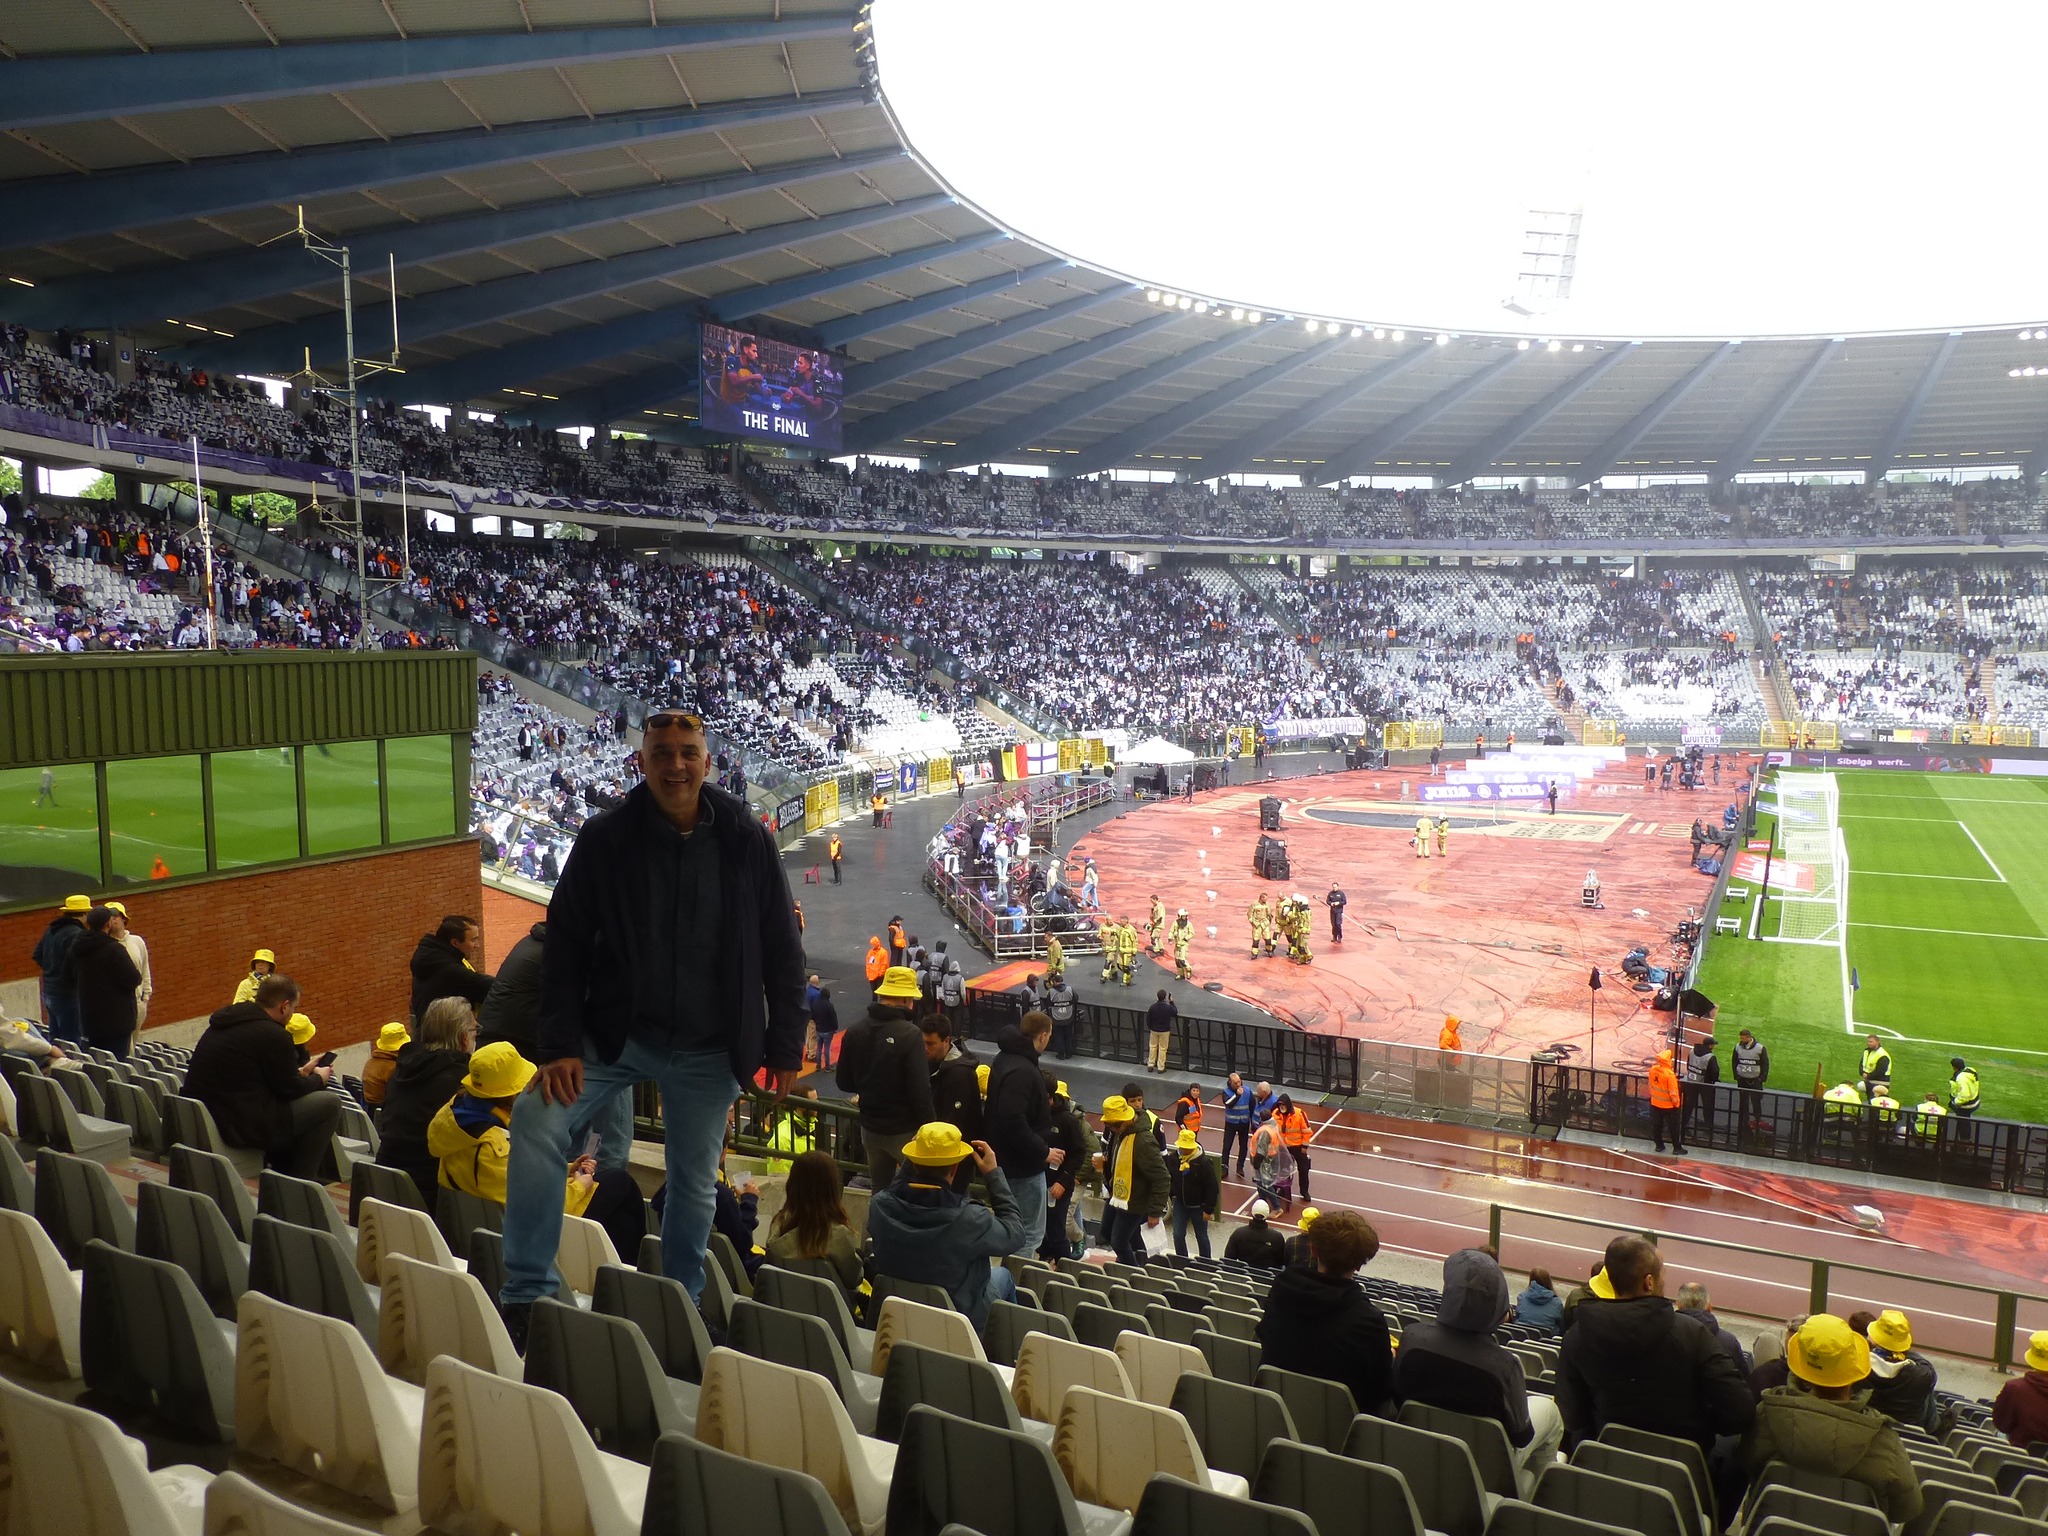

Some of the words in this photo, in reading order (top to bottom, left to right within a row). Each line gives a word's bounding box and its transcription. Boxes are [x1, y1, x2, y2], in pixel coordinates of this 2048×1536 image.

[742, 410, 769, 431] THE
[774, 416, 810, 438] FINAL
[1276, 719, 1310, 737] SOUTH
[1324, 718, 1364, 734] LEADERS
[1837, 757, 1872, 767] Sibelga
